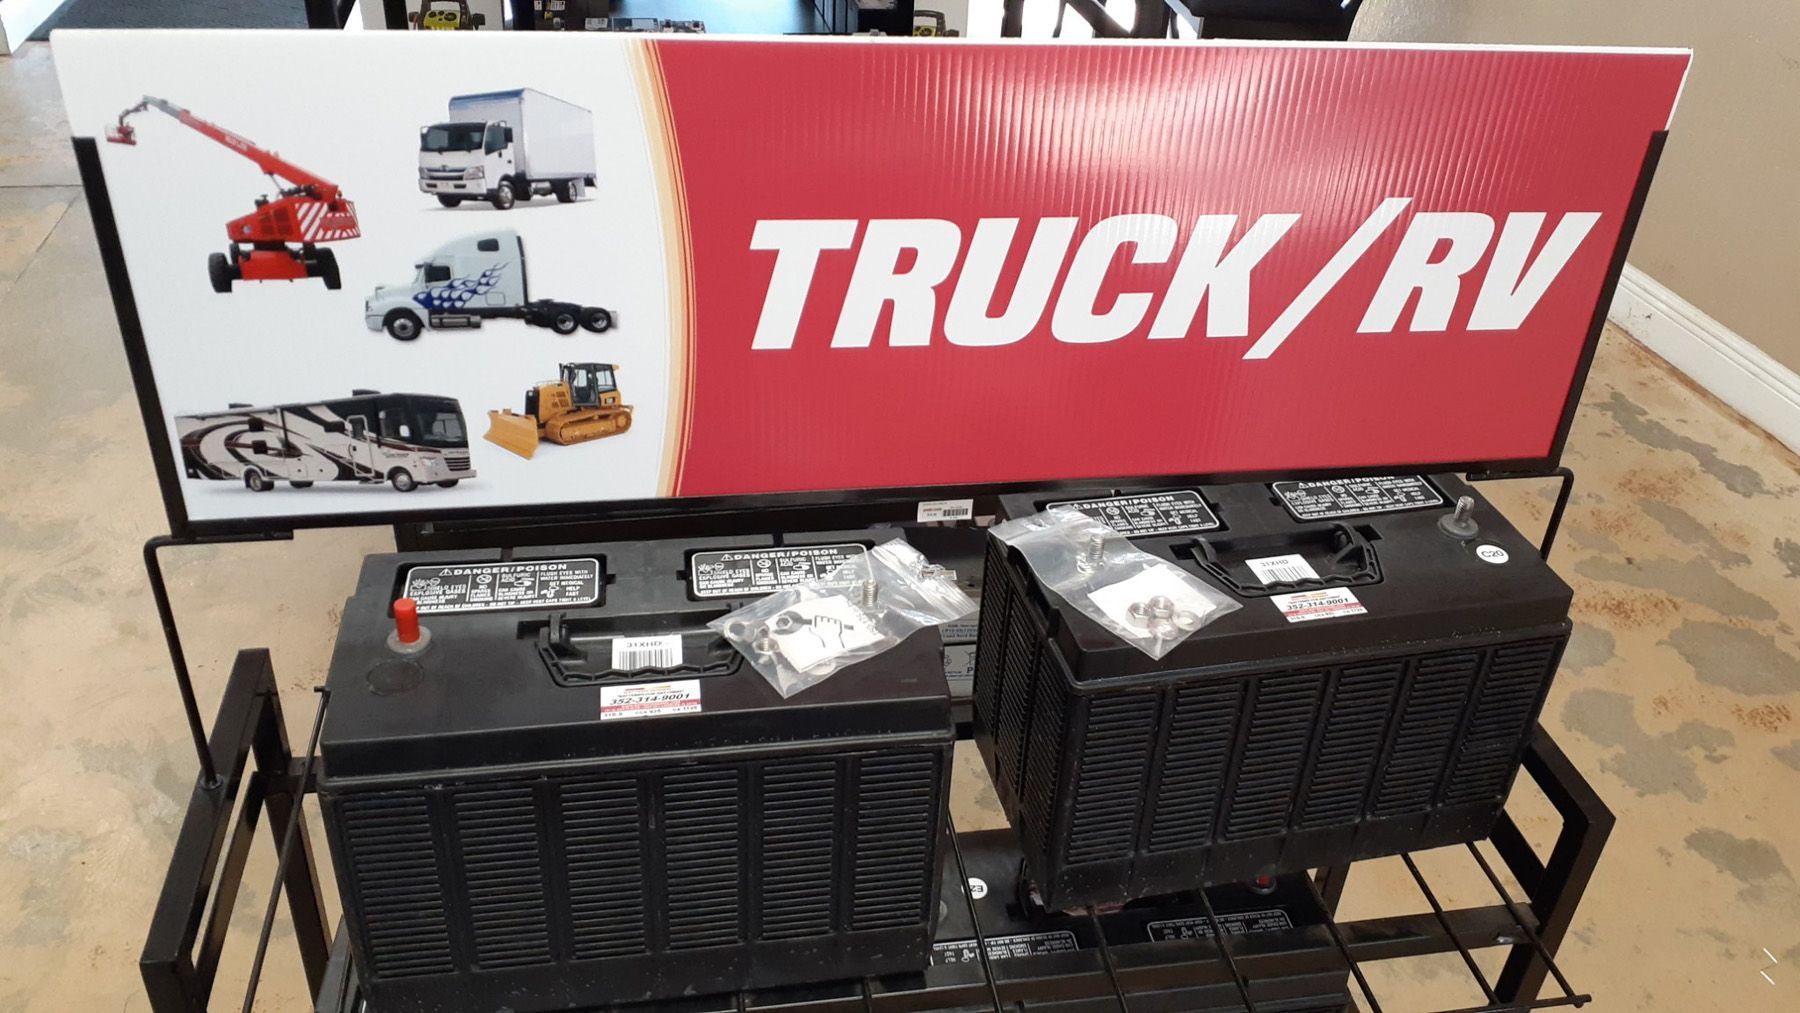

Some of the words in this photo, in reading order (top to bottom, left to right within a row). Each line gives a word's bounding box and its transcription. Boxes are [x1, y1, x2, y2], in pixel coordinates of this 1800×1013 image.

[749, 197, 1602, 360] TRUCK/RV
[1082, 496, 1175, 509] DANGER/POISON
[734, 549, 838, 560] DANGER/POISON
[453, 564, 567, 576] DANGER/POISON
[1286, 597, 1349, 611] 352-314-9001
[609, 693, 690, 706] 352-314-9001
